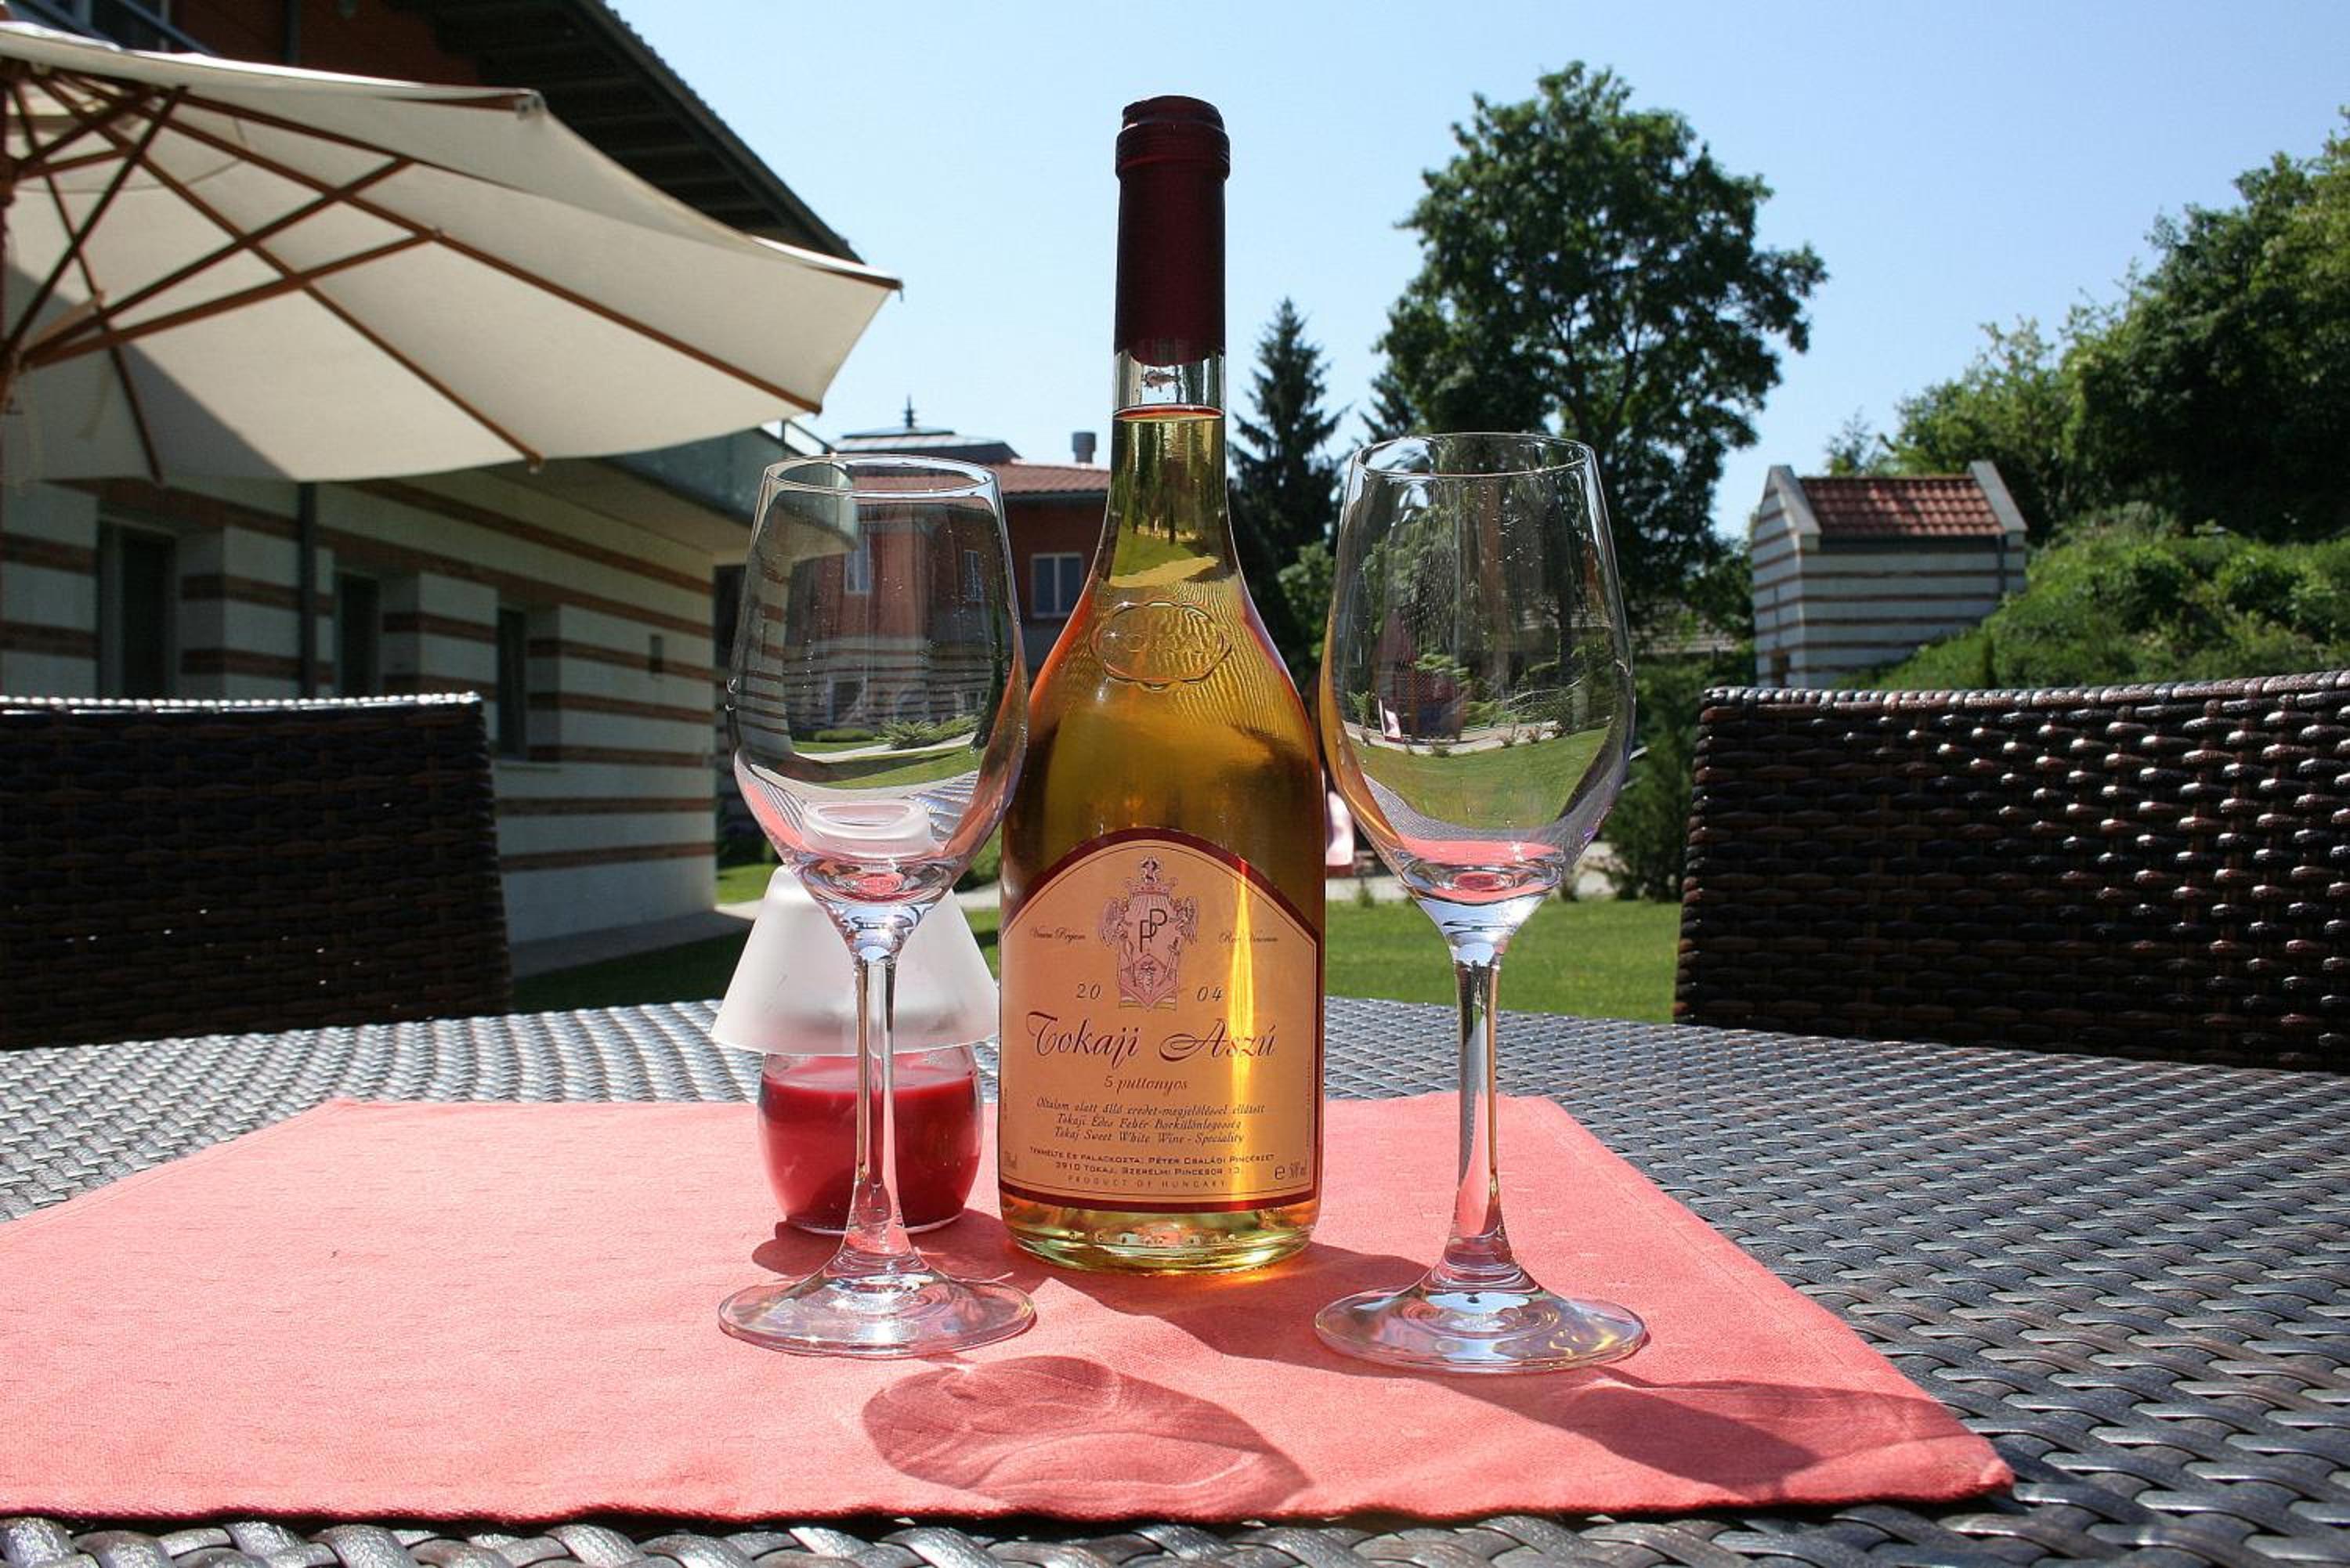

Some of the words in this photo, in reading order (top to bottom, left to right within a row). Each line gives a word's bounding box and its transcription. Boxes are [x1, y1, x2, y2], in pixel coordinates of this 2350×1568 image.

[1077, 983, 1101, 999] 20
[1197, 986, 1221, 1002] 04
[1026, 1011, 1141, 1070] Tokaji
[1159, 1018, 1276, 1061] Aszú
[1104, 1075, 1113, 1088] 5
[1116, 1077, 1188, 1096] puttonyos
[1084, 1129, 1112, 1141] Sweet
[1119, 1131, 1151, 1143] White
